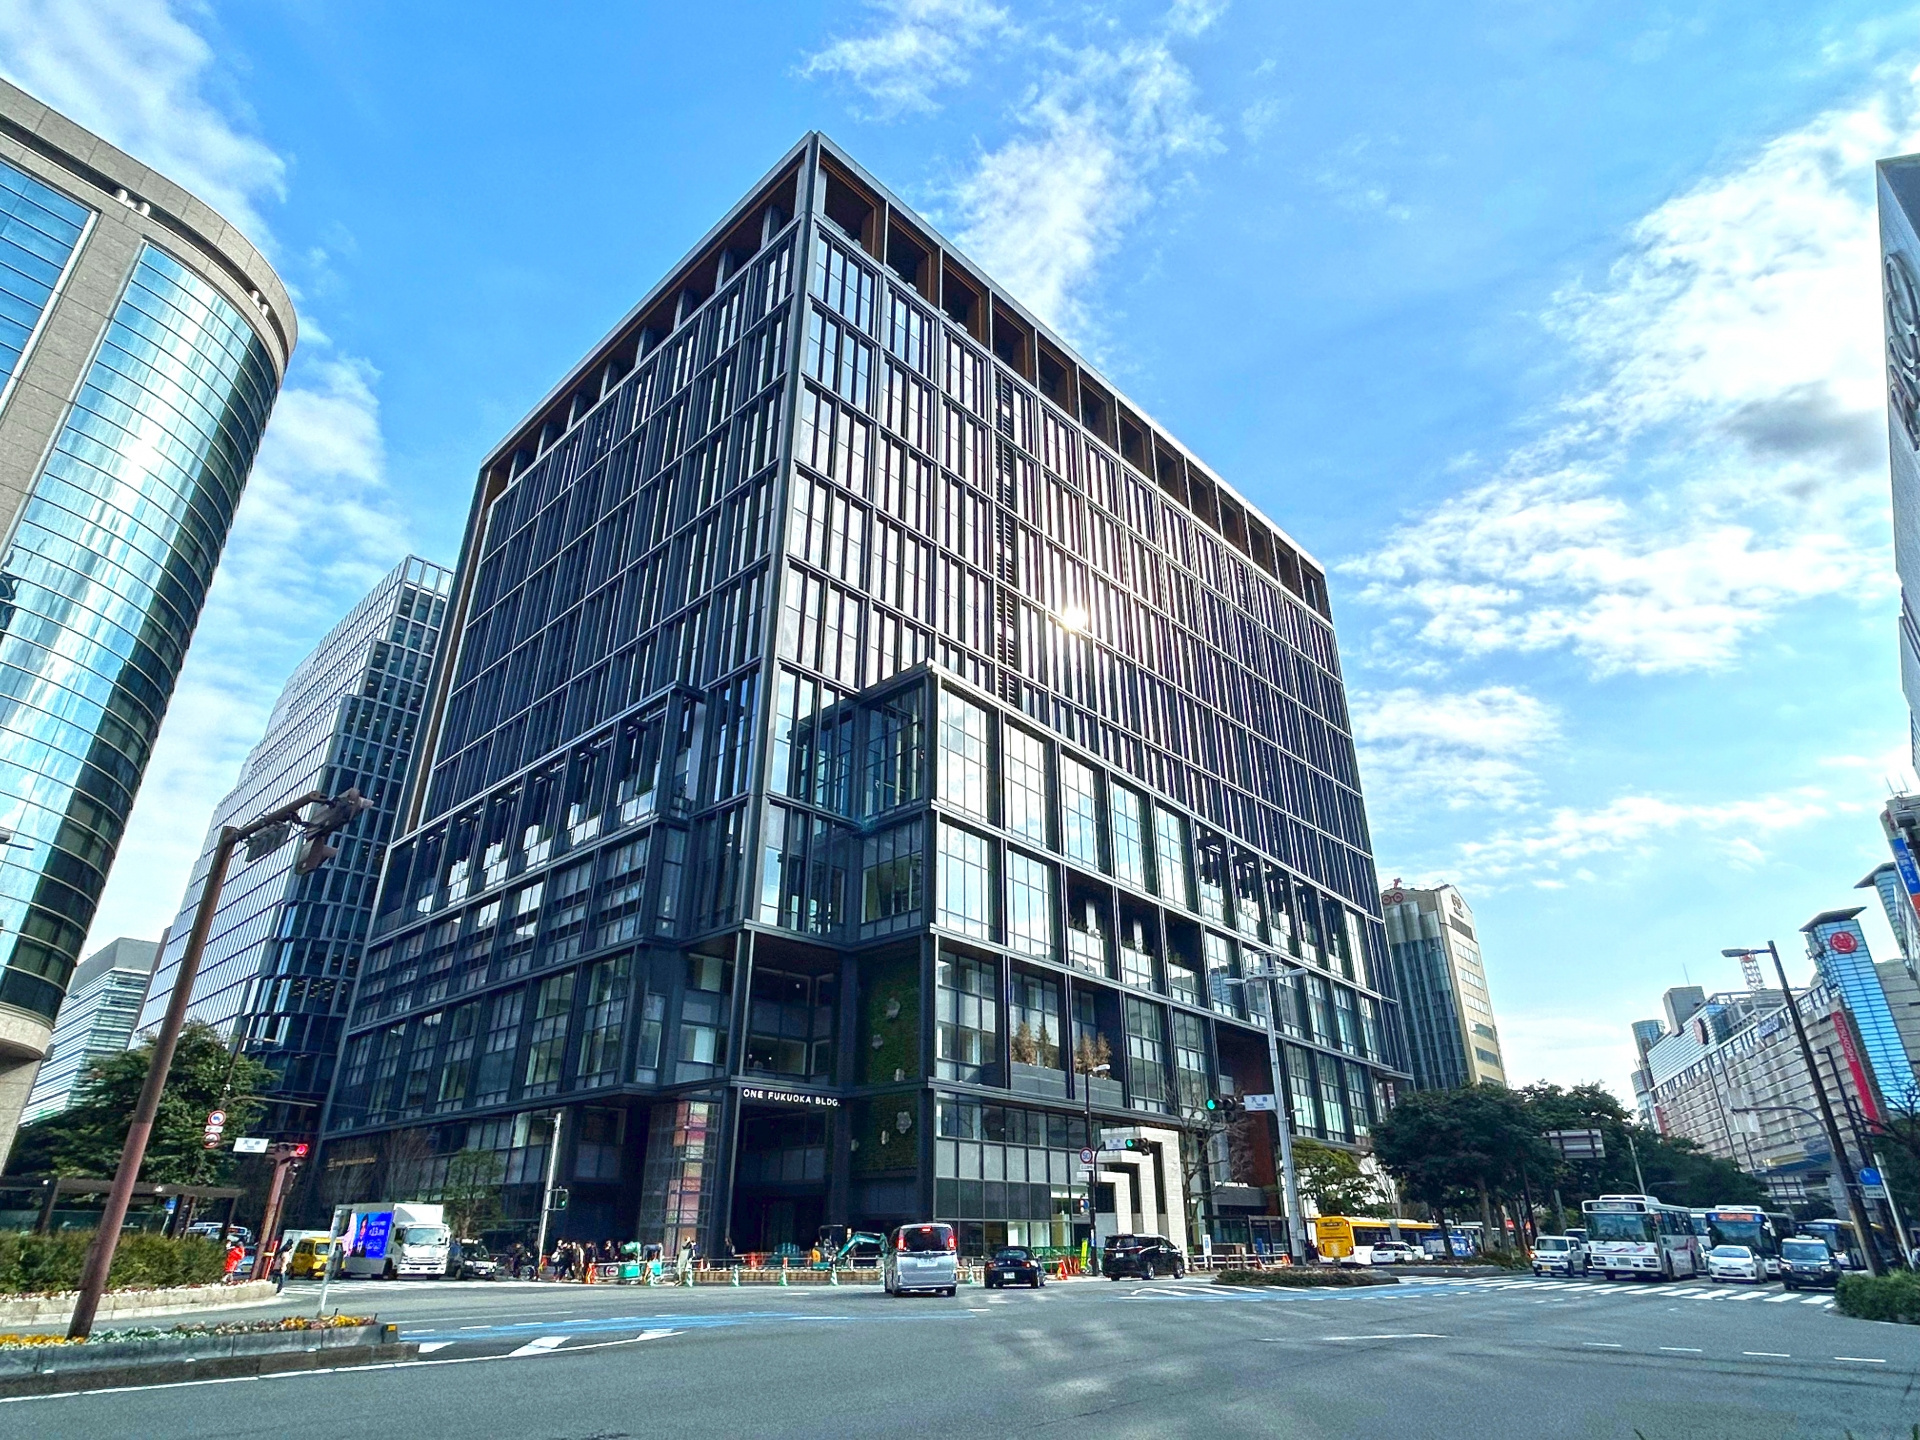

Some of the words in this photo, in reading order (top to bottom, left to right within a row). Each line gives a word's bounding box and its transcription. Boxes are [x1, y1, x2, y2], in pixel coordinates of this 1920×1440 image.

[1835, 1014, 1857, 1062] MITSUKOSHI
[743, 1088, 763, 1099] ONE
[768, 1091, 811, 1104] FUKUOKA
[815, 1097, 840, 1107] BLDG.
